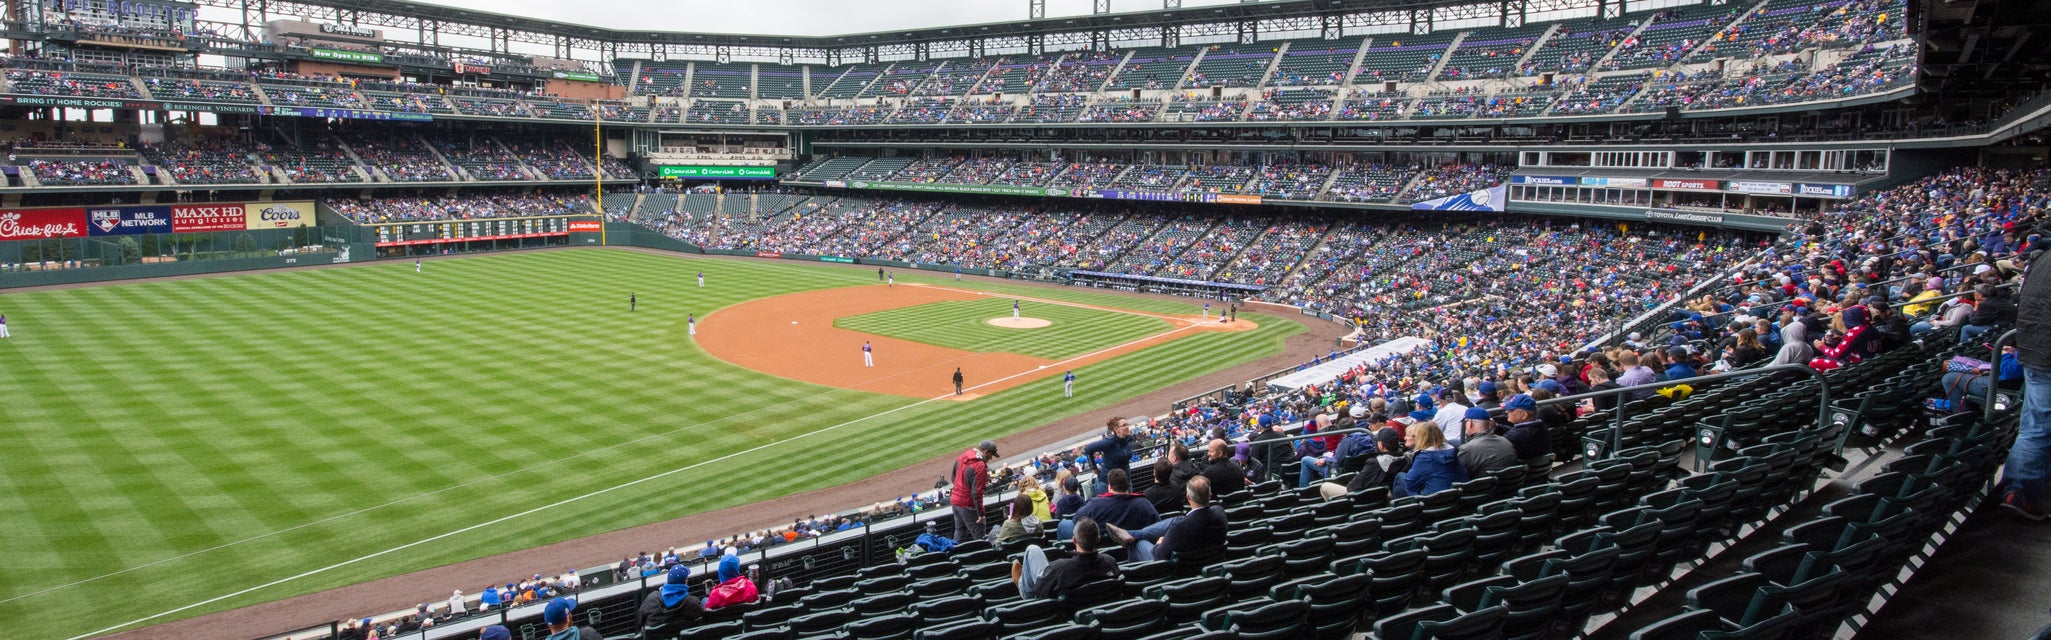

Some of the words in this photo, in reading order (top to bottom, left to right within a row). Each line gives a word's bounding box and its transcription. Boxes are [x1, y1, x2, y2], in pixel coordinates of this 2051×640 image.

[107, 0, 199, 21] ROOFTOP
[17, 97, 45, 105] BRING
[1663, 180, 1682, 188] ROOT
[93, 210, 119, 219] MLB
[174, 207, 220, 218] MAXX
[221, 206, 244, 217] HD
[260, 207, 300, 221] Coors
[121, 218, 167, 227] NETWORK
[174, 216, 244, 225] sunglasses
[1706, 215, 1723, 223] CLUB
[0, 218, 79, 238] Chick-fil-A
